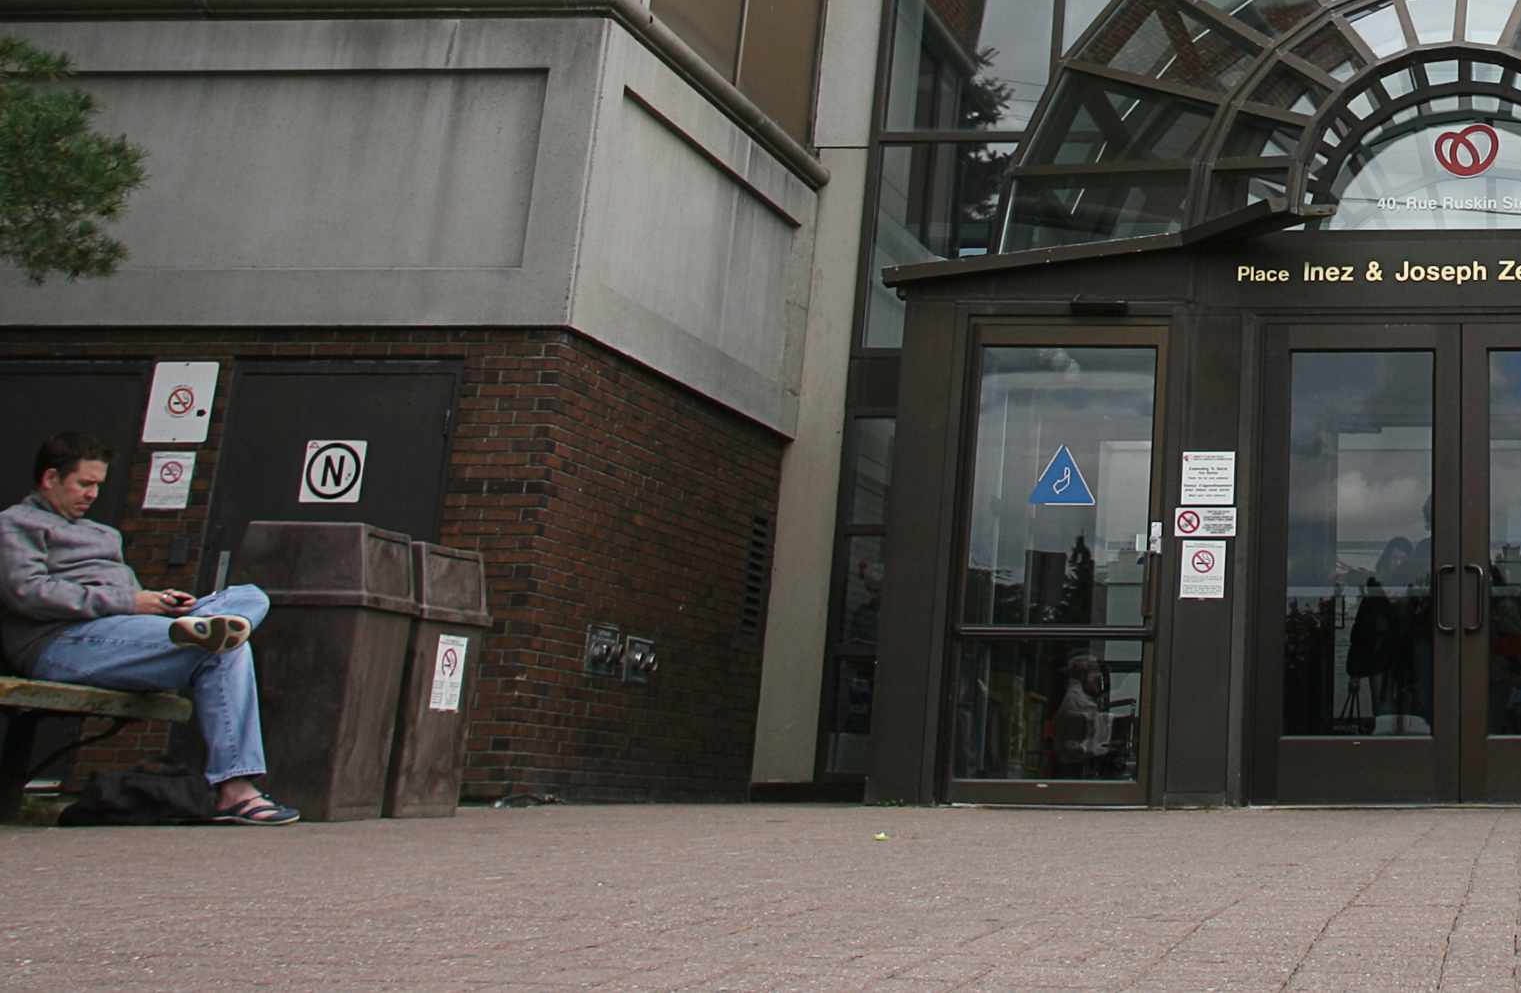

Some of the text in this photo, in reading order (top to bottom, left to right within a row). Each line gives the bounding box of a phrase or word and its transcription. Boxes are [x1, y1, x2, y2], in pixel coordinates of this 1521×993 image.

[1377, 197, 1400, 212] 40,
[1406, 196, 1438, 210] Rue
[1443, 196, 1497, 211] Ruskin
[1237, 265, 1290, 282] Place
[1303, 261, 1355, 282] Inez
[1365, 260, 1384, 282] &
[1395, 260, 1488, 286] Joseph
[321, 455, 346, 487] N
